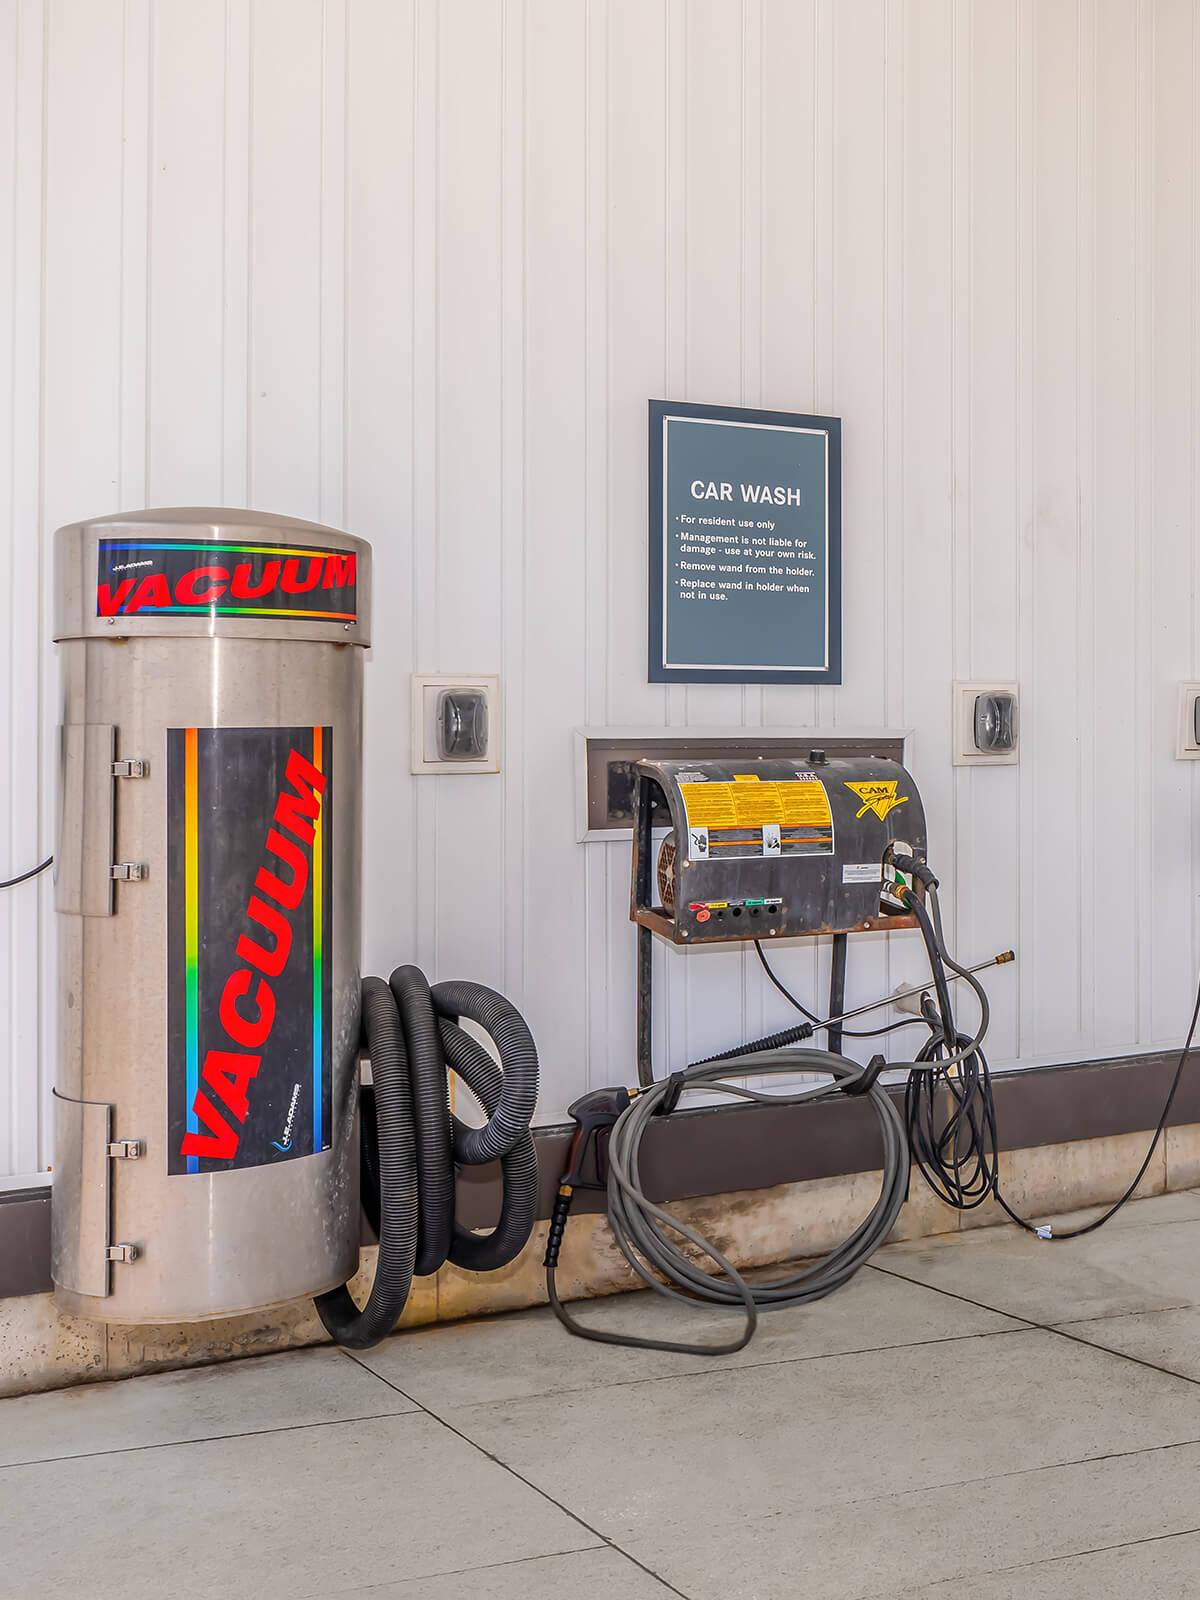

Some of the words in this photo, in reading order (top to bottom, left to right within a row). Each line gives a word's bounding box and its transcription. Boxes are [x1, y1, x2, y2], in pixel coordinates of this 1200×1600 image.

[691, 480, 733, 501] CAR
[740, 484, 801, 506] WASH
[681, 514, 696, 524] For
[699, 516, 735, 526] resident
[738, 519, 754, 528] use
[757, 520, 775, 531] only
[681, 532, 738, 544] Management
[741, 536, 749, 544] is
[752, 537, 767, 545] not
[769, 537, 792, 547] liable
[795, 539, 807, 548] for
[680, 544, 716, 555] damage
[725, 547, 740, 555] use
[743, 548, 752, 556] at
[755, 549, 774, 558] your
[777, 550, 795, 558] own
[798, 551, 817, 560] risk.
[680, 561, 716, 571] Remove
[719, 564, 742, 573] wand
[745, 565, 766, 574] from
[769, 566, 783, 575] the
[786, 567, 815, 576] holder.
[97, 553, 356, 617] VACUUM
[680, 579, 716, 589] Replace
[719, 581, 742, 590] wand
[745, 582, 754, 590] in
[756, 582, 784, 592] holder
[787, 584, 810, 593] when
[680, 591, 695, 599] not
[698, 591, 706, 599] in
[710, 592, 728, 601] use.
[859, 786, 889, 794] CAM
[179, 748, 327, 1160] VACUUM
